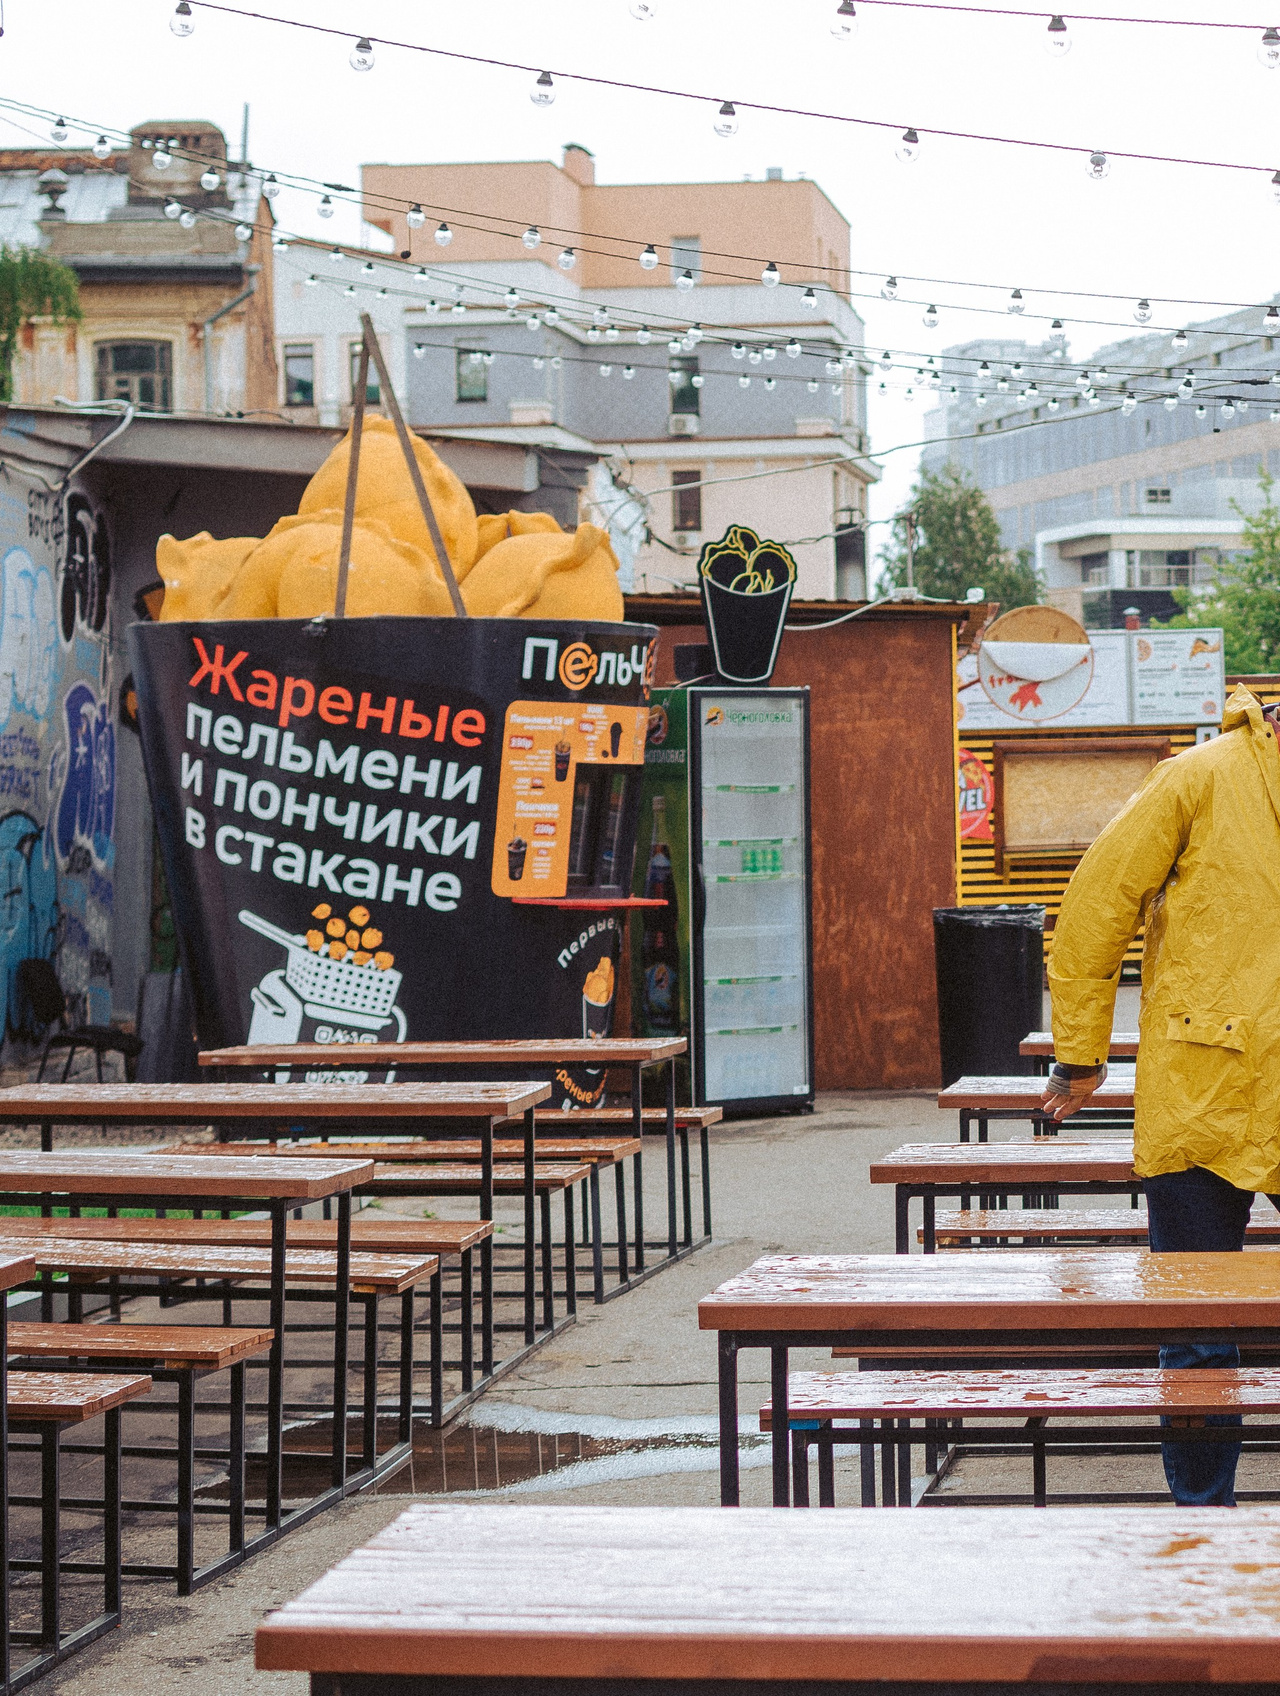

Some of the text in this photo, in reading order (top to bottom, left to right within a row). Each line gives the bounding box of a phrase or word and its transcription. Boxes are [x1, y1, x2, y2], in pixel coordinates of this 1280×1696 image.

[188, 637, 487, 747] Жареные
[726, 711, 794, 727] Черноголовка
[186, 702, 483, 805] пельмени
[181, 752, 481, 860] и пончики
[185, 806, 206, 850] в
[214, 825, 462, 912] стакане
[557, 917, 615, 969] Первые
[556, 1068, 594, 1104] реные
